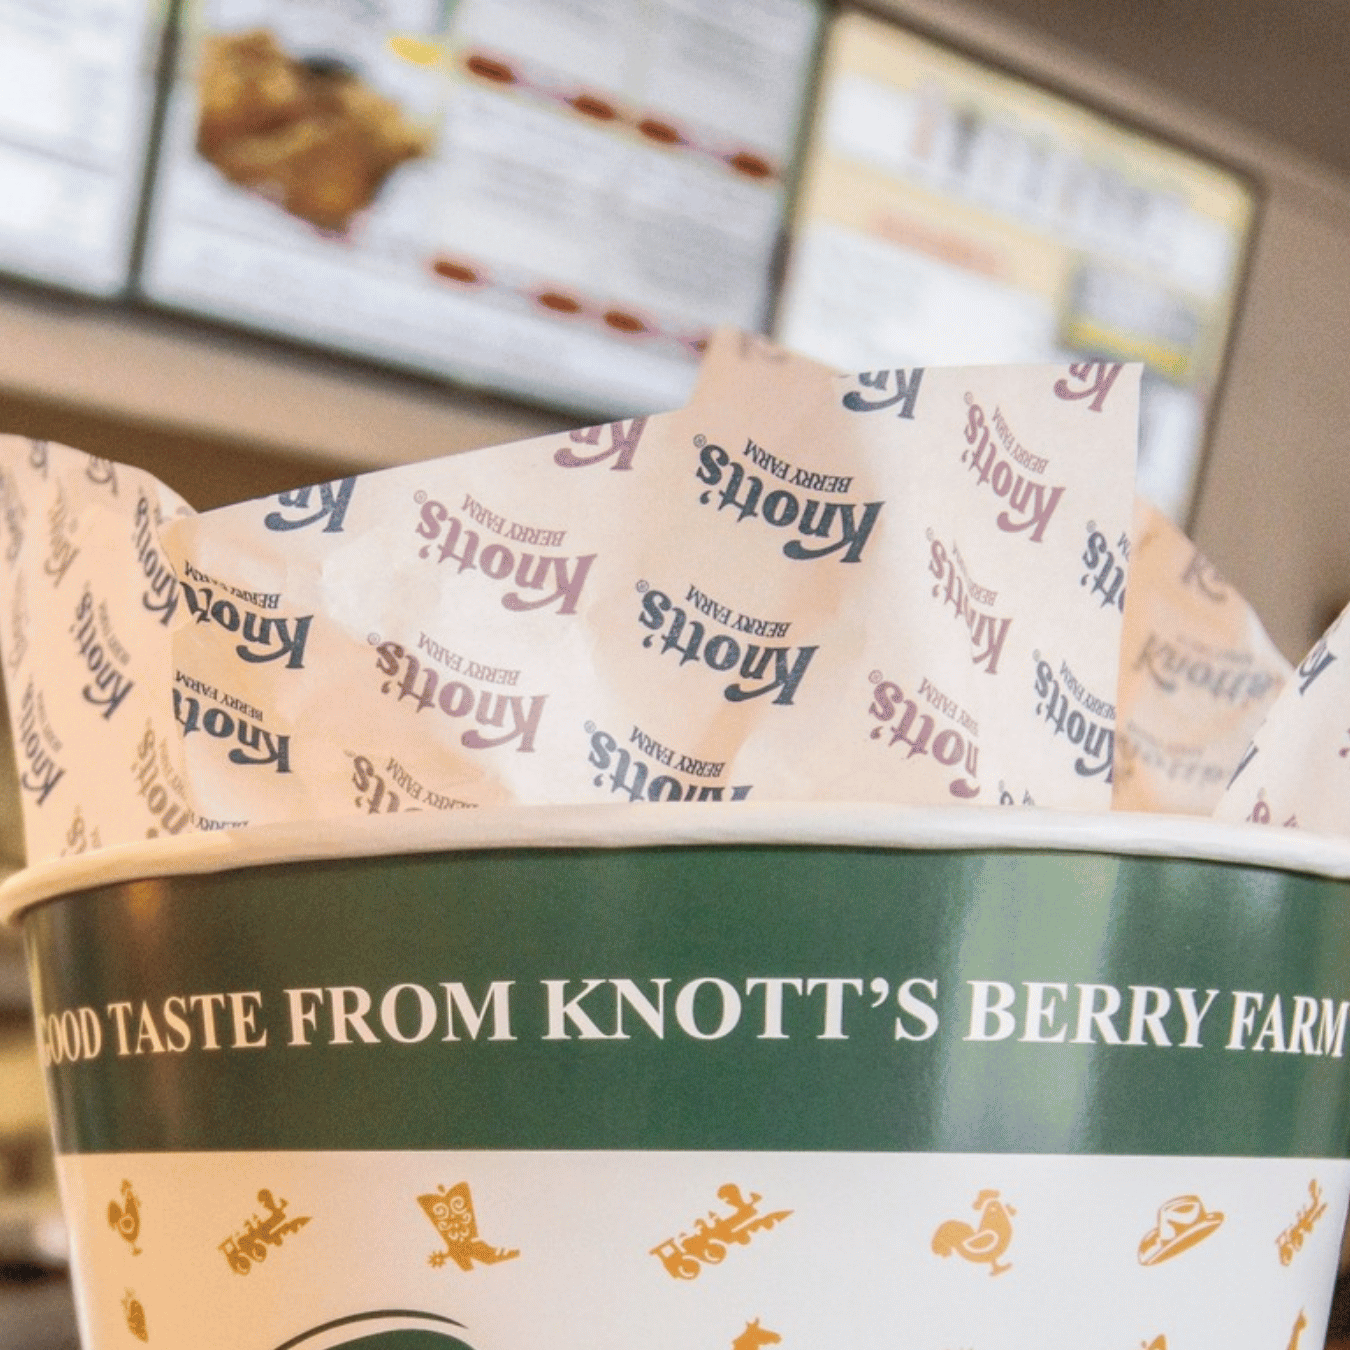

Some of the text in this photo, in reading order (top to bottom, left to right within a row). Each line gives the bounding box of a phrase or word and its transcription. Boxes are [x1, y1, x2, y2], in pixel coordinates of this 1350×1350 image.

[695, 444, 886, 563] Knott's
[742, 438, 855, 494] BERRY FARM
[961, 404, 1065, 543] Knott's
[415, 500, 598, 615] Knott's
[460, 493, 567, 547] BERRY FARM
[685, 584, 792, 638] BERRY FARM
[1081, 531, 1126, 614] tt's
[417, 631, 521, 686] BERRY FARM
[638, 590, 820, 705] Knott's
[175, 669, 264, 722] BERRY FARM
[376, 641, 550, 753] Knott's
[629, 725, 726, 778] BERRY FARM
[107, 990, 268, 1056] TASTE
[283, 979, 518, 1047] FROM
[540, 976, 940, 1042] KNOTT'S
[963, 979, 1220, 1048] BERRY
[1225, 990, 1349, 1058] FARM
